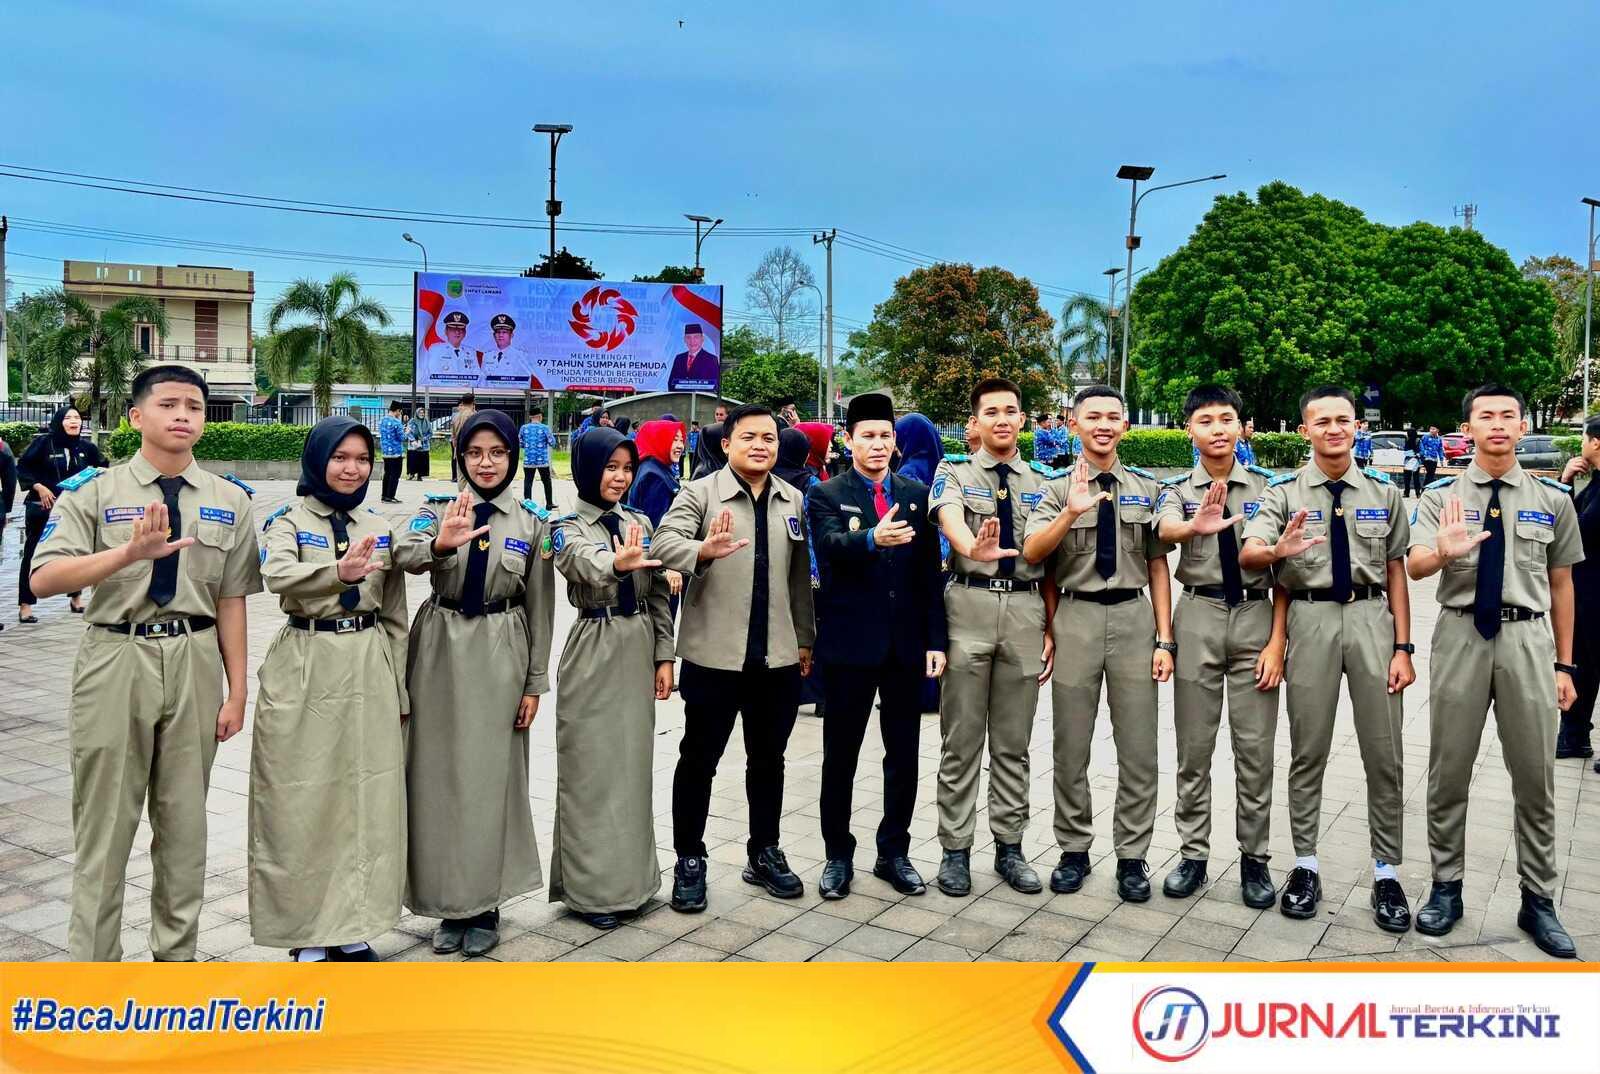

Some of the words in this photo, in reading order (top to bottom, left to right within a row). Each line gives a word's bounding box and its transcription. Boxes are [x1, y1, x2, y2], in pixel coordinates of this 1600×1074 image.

[551, 360, 583, 368] TAHUN
[587, 361, 626, 369] SUMPAH
[629, 362, 667, 370] PEMUDA
[546, 368, 581, 376] PEMUDA
[583, 369, 614, 377] PEMUDI
[616, 370, 658, 378] BERGERAK
[561, 376, 606, 384] INDONESIA
[608, 377, 645, 385] BERSATU
